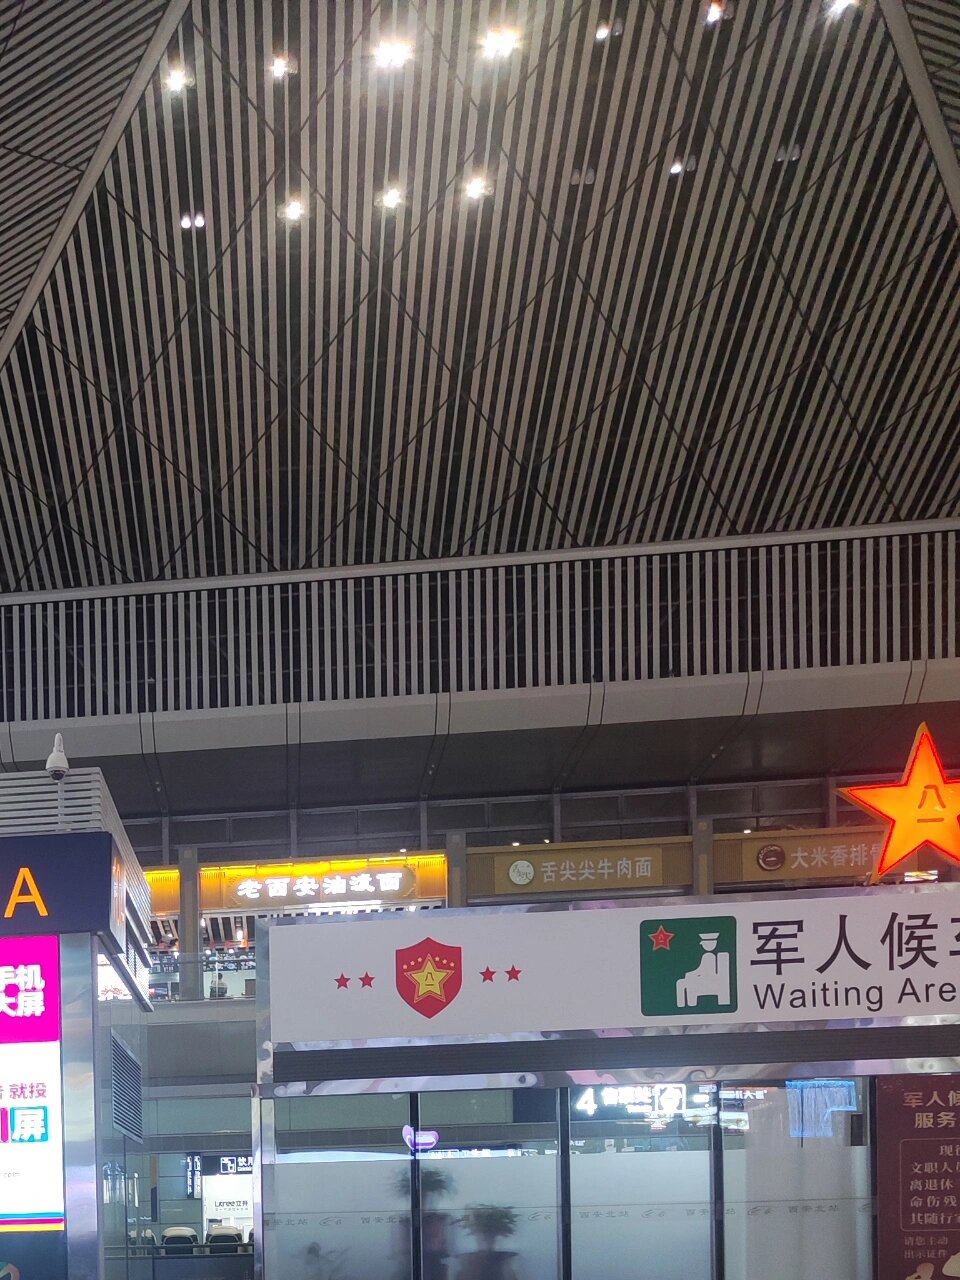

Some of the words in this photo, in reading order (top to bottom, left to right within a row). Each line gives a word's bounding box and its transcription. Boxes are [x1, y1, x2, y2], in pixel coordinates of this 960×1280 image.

[541, 857, 652, 882] 舌尖尖牛肉面
[750, 912, 960, 975] 军人候
[753, 981, 883, 1012] Waiting
[9, 1082, 48, 1100] 就投
[915, 1112, 960, 1128] 服务
